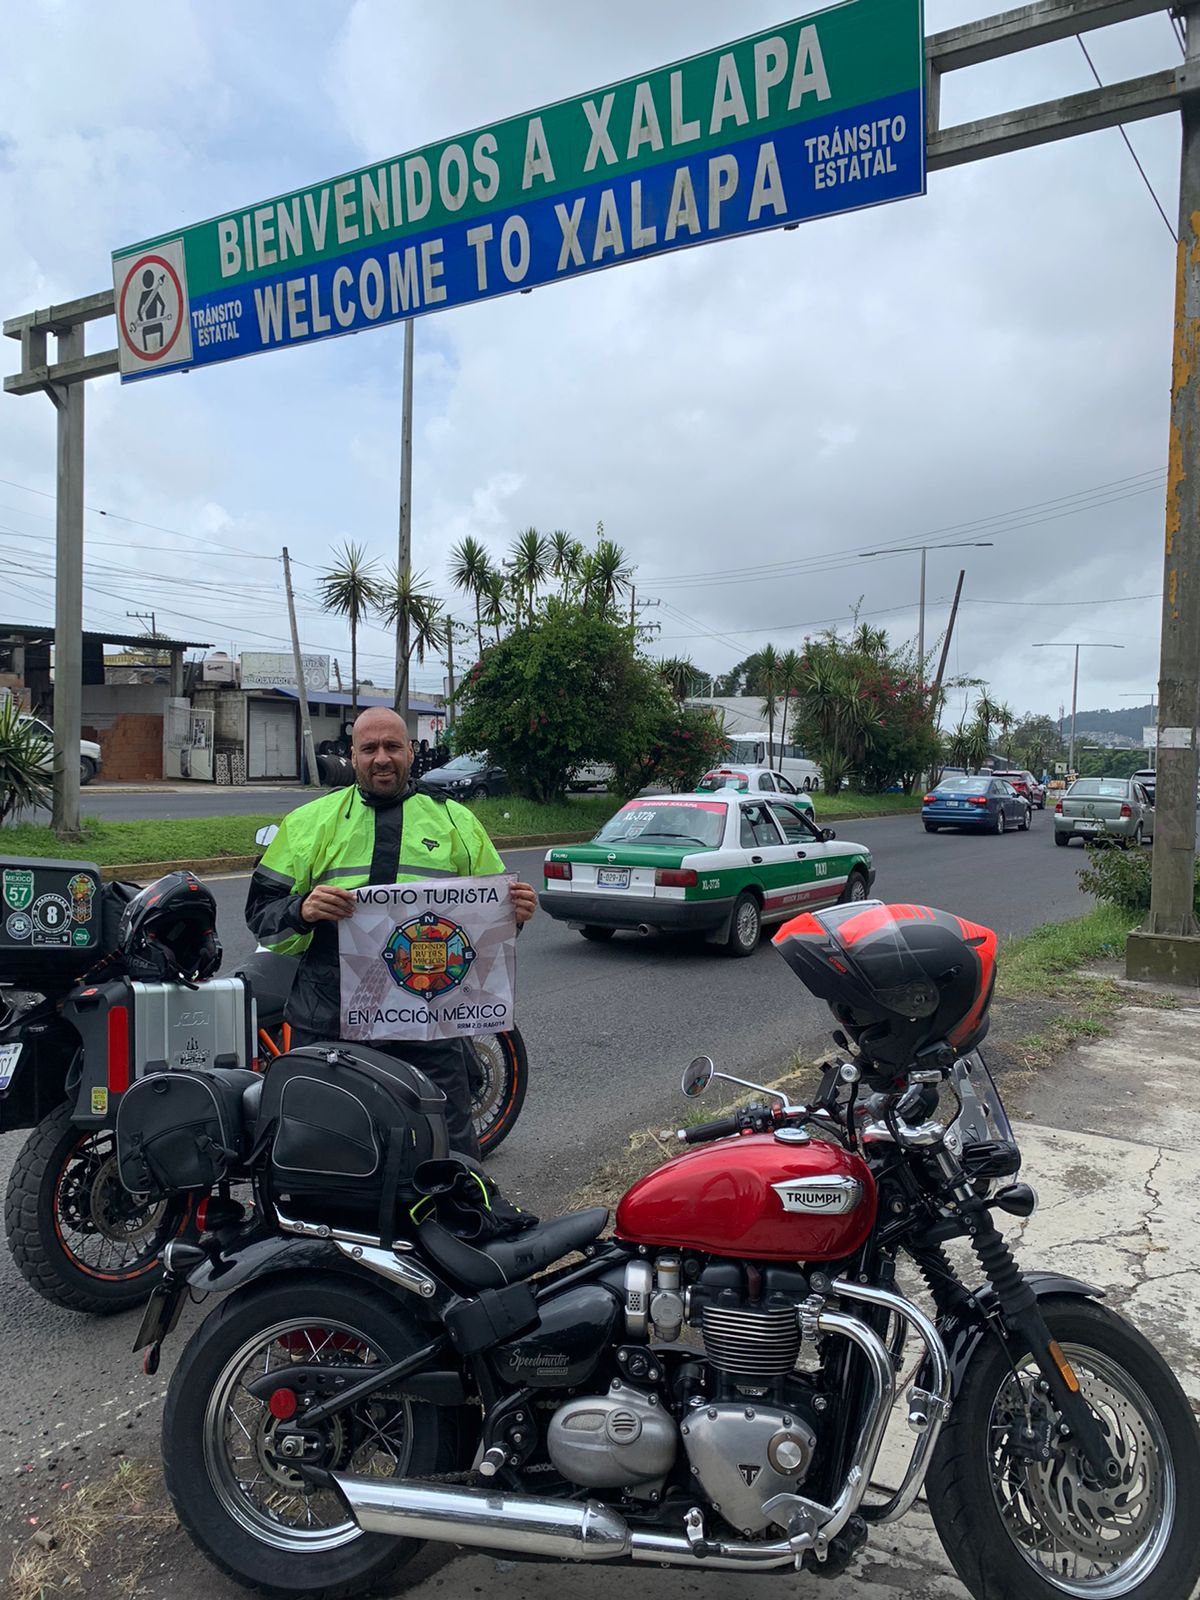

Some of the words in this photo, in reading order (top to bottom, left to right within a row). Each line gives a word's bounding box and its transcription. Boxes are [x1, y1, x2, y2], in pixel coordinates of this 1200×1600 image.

[804, 115, 906, 163] TRÁNSITO
[218, 133, 500, 278] BIENVENIDOS
[522, 116, 556, 189] A
[582, 23, 832, 172] XALAPA
[815, 147, 897, 190] ESTATAL
[254, 239, 447, 344] WELCOME
[466, 214, 531, 292] TO
[554, 141, 788, 271] XALAPA
[192, 299, 242, 328] TRÁNSITO
[198, 320, 240, 347] ESTATAL
[304, 669, 321, 685] 66
[624, 811, 657, 821] XL-3726
[814, 862, 828, 876] TAXI
[9, 887, 28, 901] 57
[356, 889, 417, 904] MOTO
[423, 888, 499, 904] TURISTA
[47, 906, 58, 924] 8
[425, 991, 432, 999] S
[348, 1010, 369, 1024] EN
[374, 1007, 439, 1023] ACCIÓN
[443, 1003, 507, 1021] MÉXICO
[786, 1193, 842, 1205] TRIUMPH
[509, 1348, 570, 1371] Speedmaster
